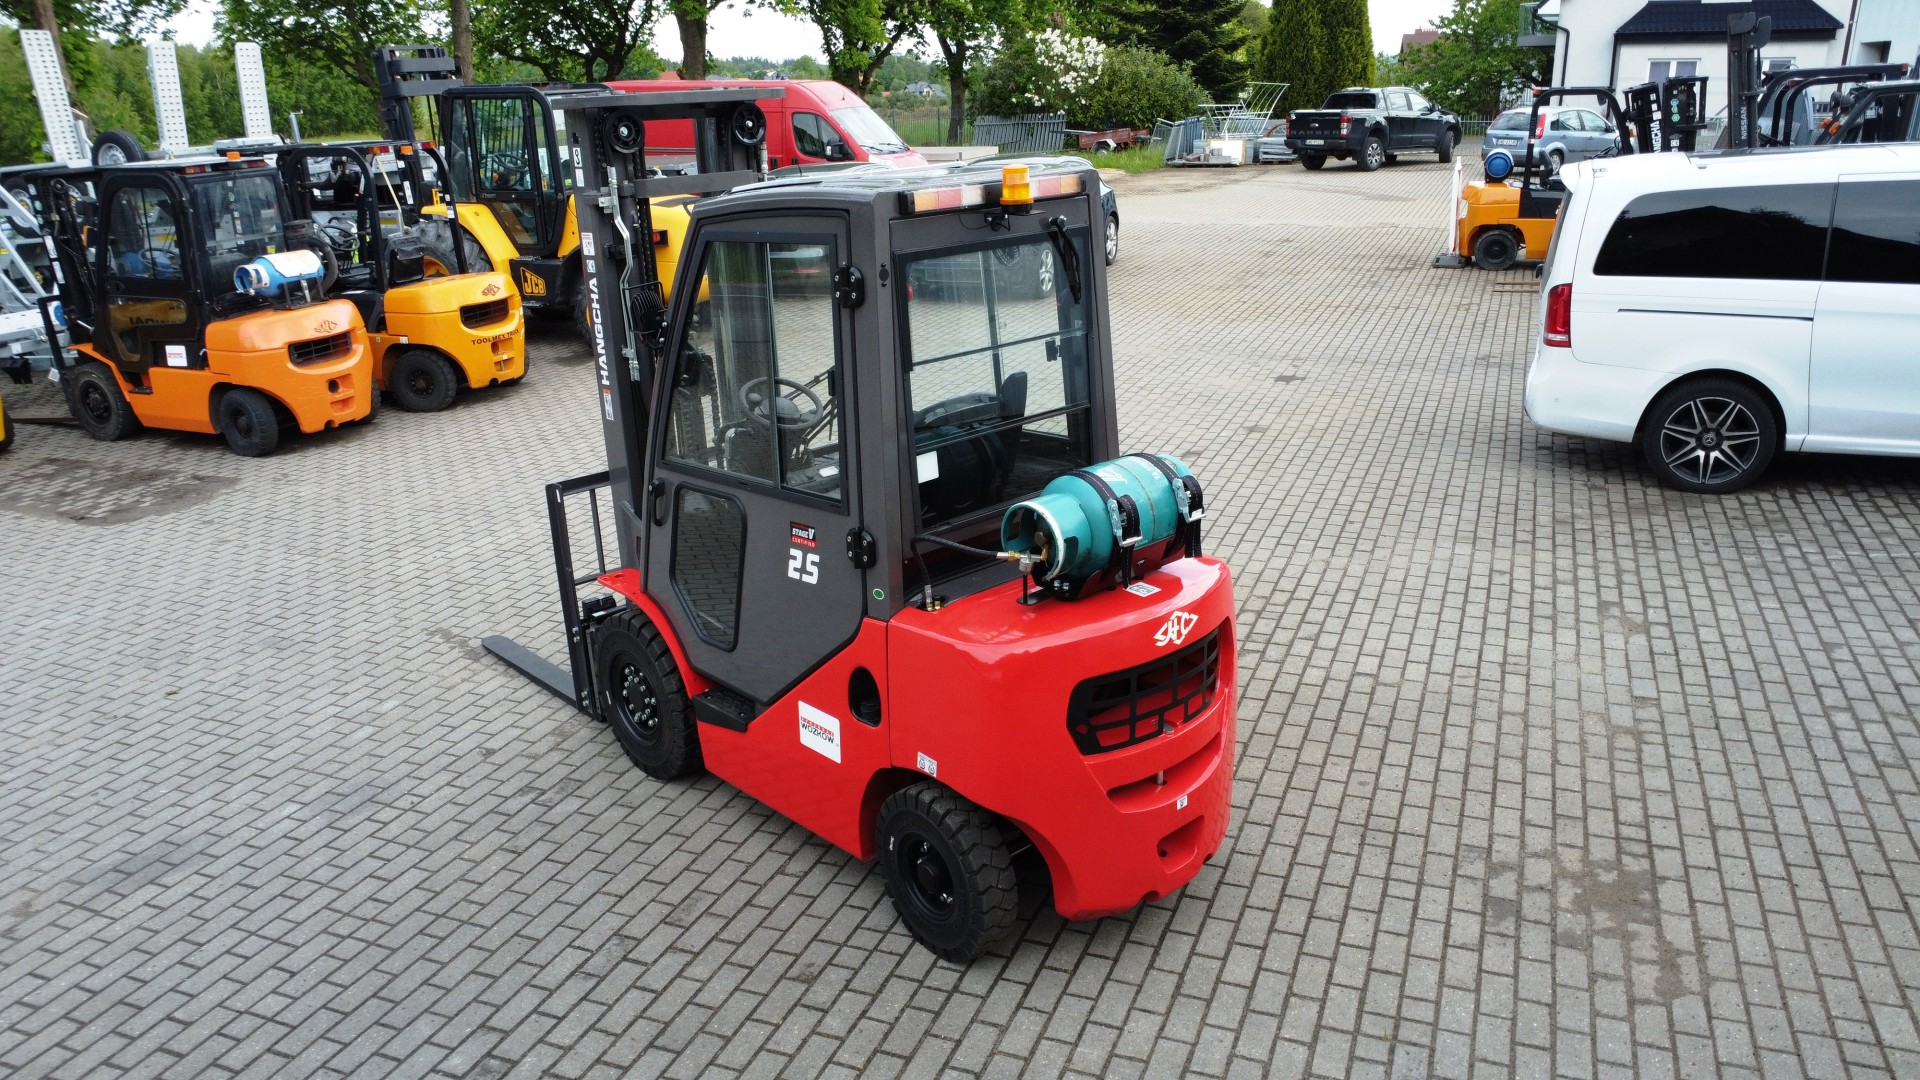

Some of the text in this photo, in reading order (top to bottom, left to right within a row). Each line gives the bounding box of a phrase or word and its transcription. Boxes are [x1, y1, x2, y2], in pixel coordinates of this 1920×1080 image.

[1650, 120, 1661, 153] ANGCHA
[525, 271, 545, 294] JCB
[471, 333, 506, 346] TOOLMEX
[589, 277, 610, 386] HANGCHA
[792, 527, 815, 540] STAGE V
